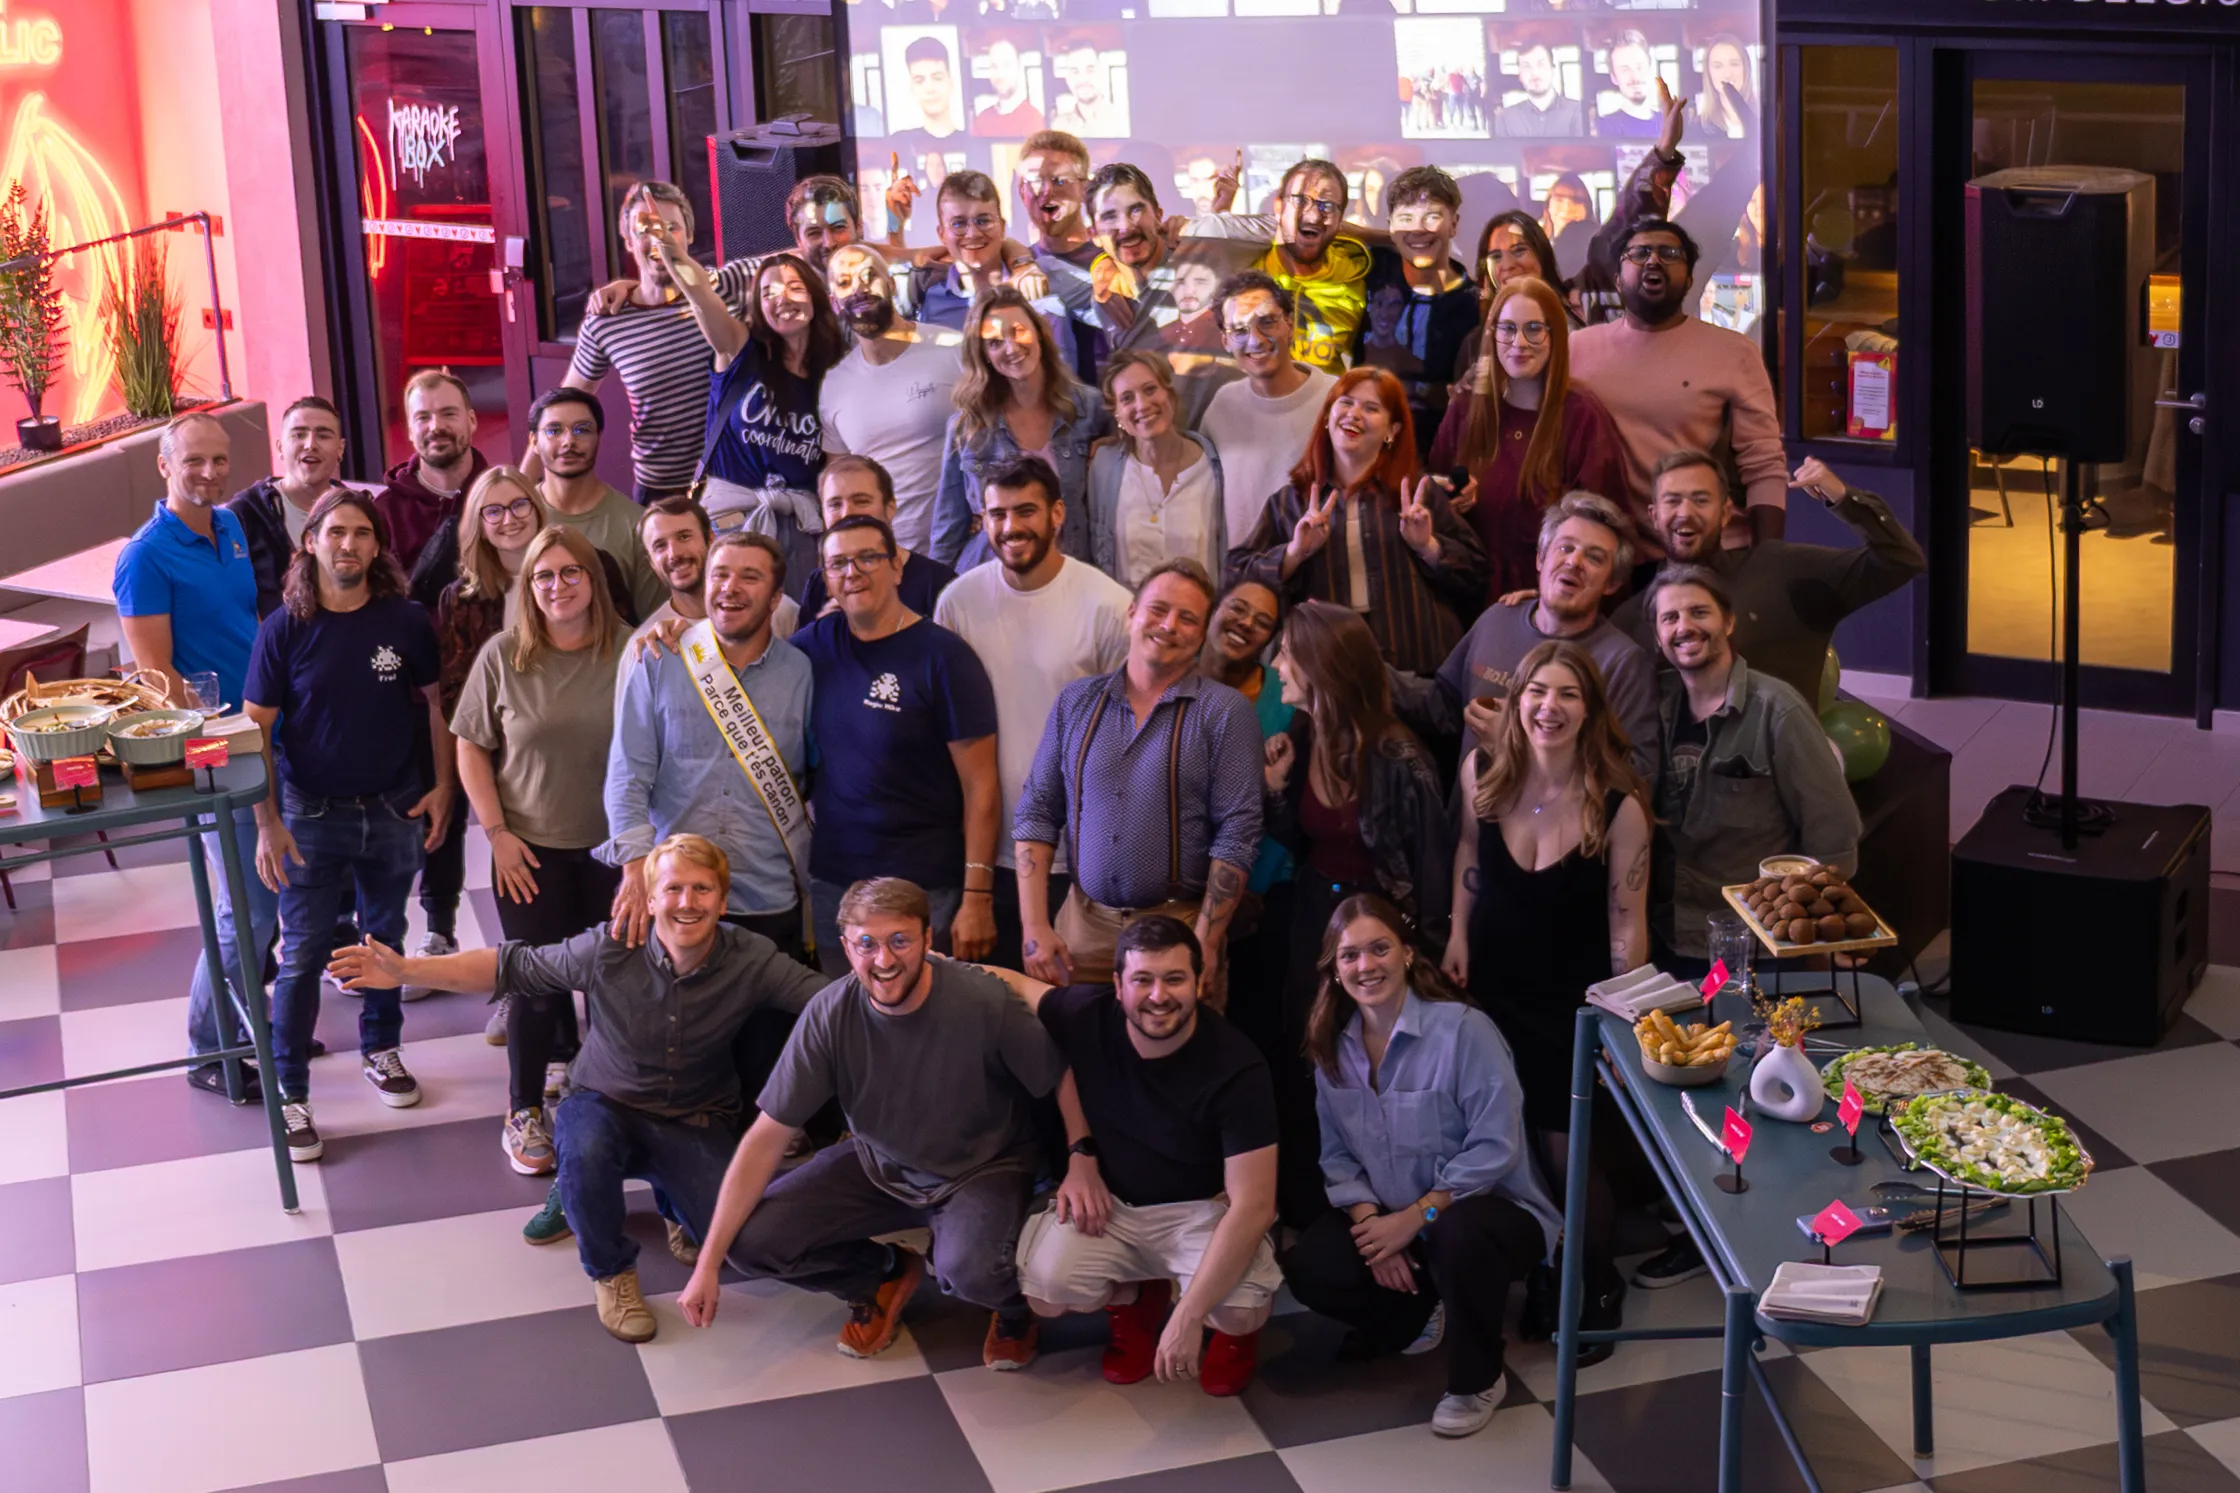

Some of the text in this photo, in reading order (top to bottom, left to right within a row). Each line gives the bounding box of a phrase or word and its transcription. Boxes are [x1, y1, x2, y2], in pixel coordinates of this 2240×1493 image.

[387, 98, 461, 157] KARAOKE
[405, 134, 446, 176] BOX
[700, 673, 729, 718] Parce
[725, 721, 749, 750] que
[745, 751, 766, 780] t'es
[763, 782, 790, 826] canon
[723, 686, 797, 807] Meilleur patron
